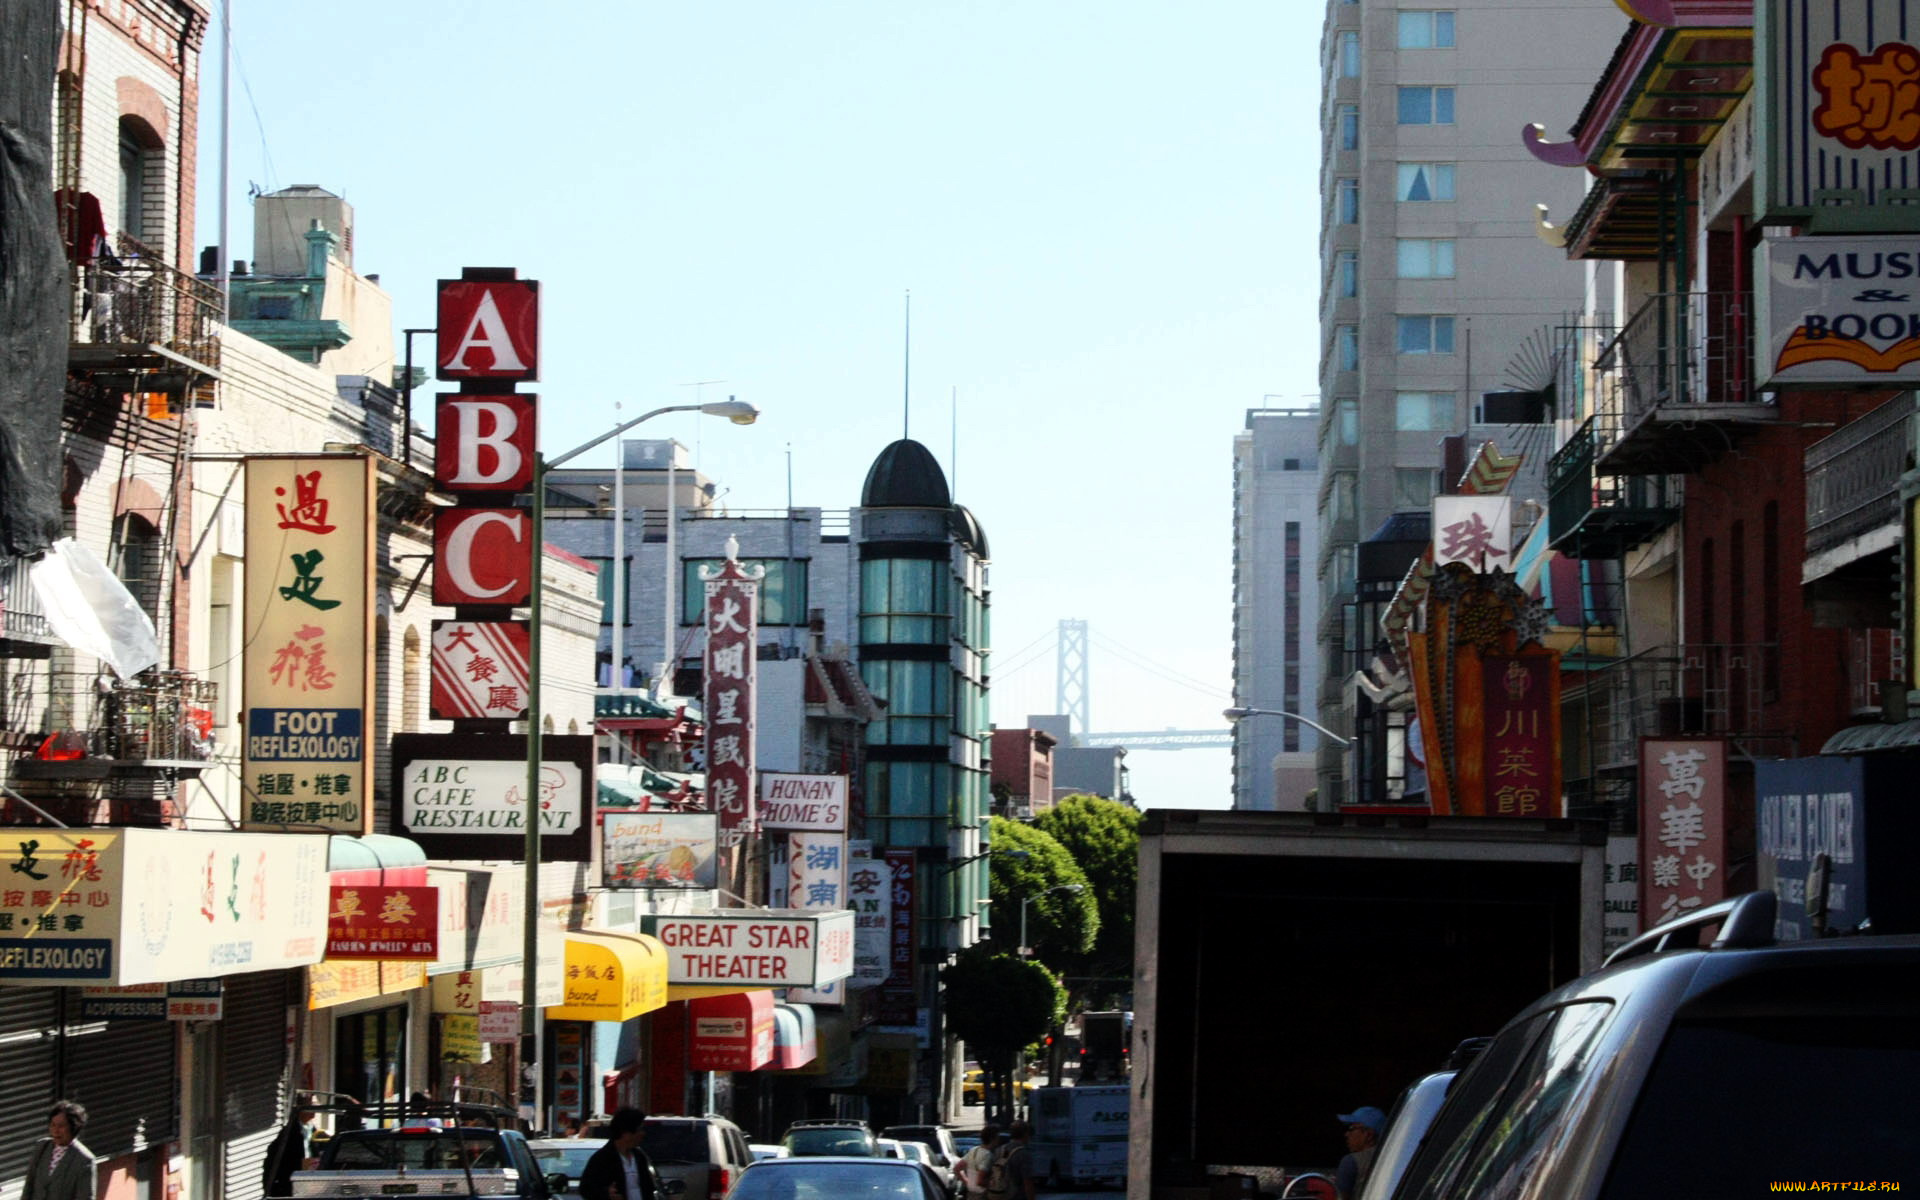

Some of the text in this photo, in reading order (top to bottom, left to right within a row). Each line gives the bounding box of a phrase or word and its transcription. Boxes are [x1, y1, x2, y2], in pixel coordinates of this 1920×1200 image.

[1852, 288, 1910, 303] &
[273, 711, 338, 734] FOOT
[250, 736, 360, 759] REFLEXOLOGY
[413, 787, 475, 806] CAFE
[660, 923, 736, 948] GREAT
[748, 925, 810, 949] STAR
[682, 953, 787, 980] THEATER
